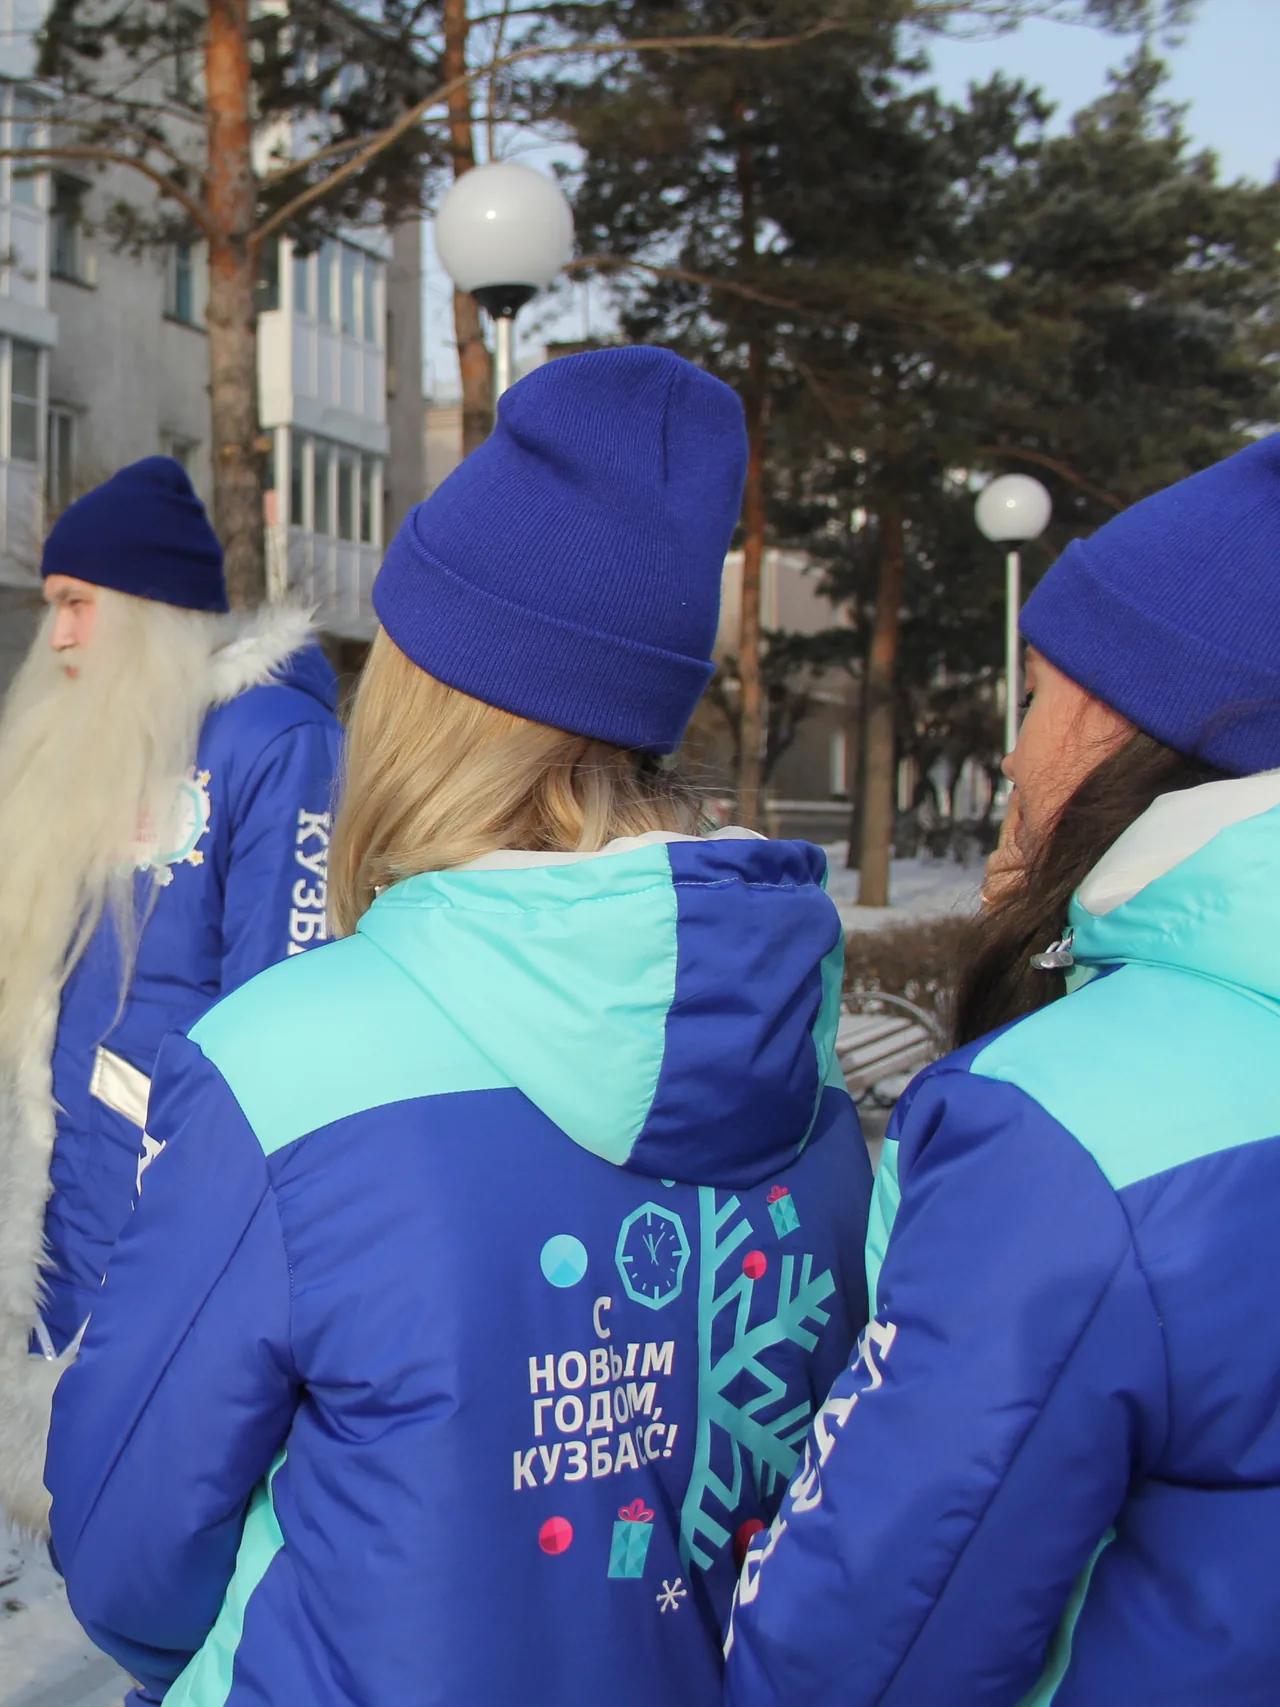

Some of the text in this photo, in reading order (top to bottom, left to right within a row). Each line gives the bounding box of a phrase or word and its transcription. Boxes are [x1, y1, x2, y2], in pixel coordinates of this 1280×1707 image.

[592, 1296, 612, 1338] С
[528, 1341, 675, 1393] НОВЫМ
[532, 1382, 664, 1436] ГОДОМ,
[513, 1423, 678, 1491] КУЗБАСС!
